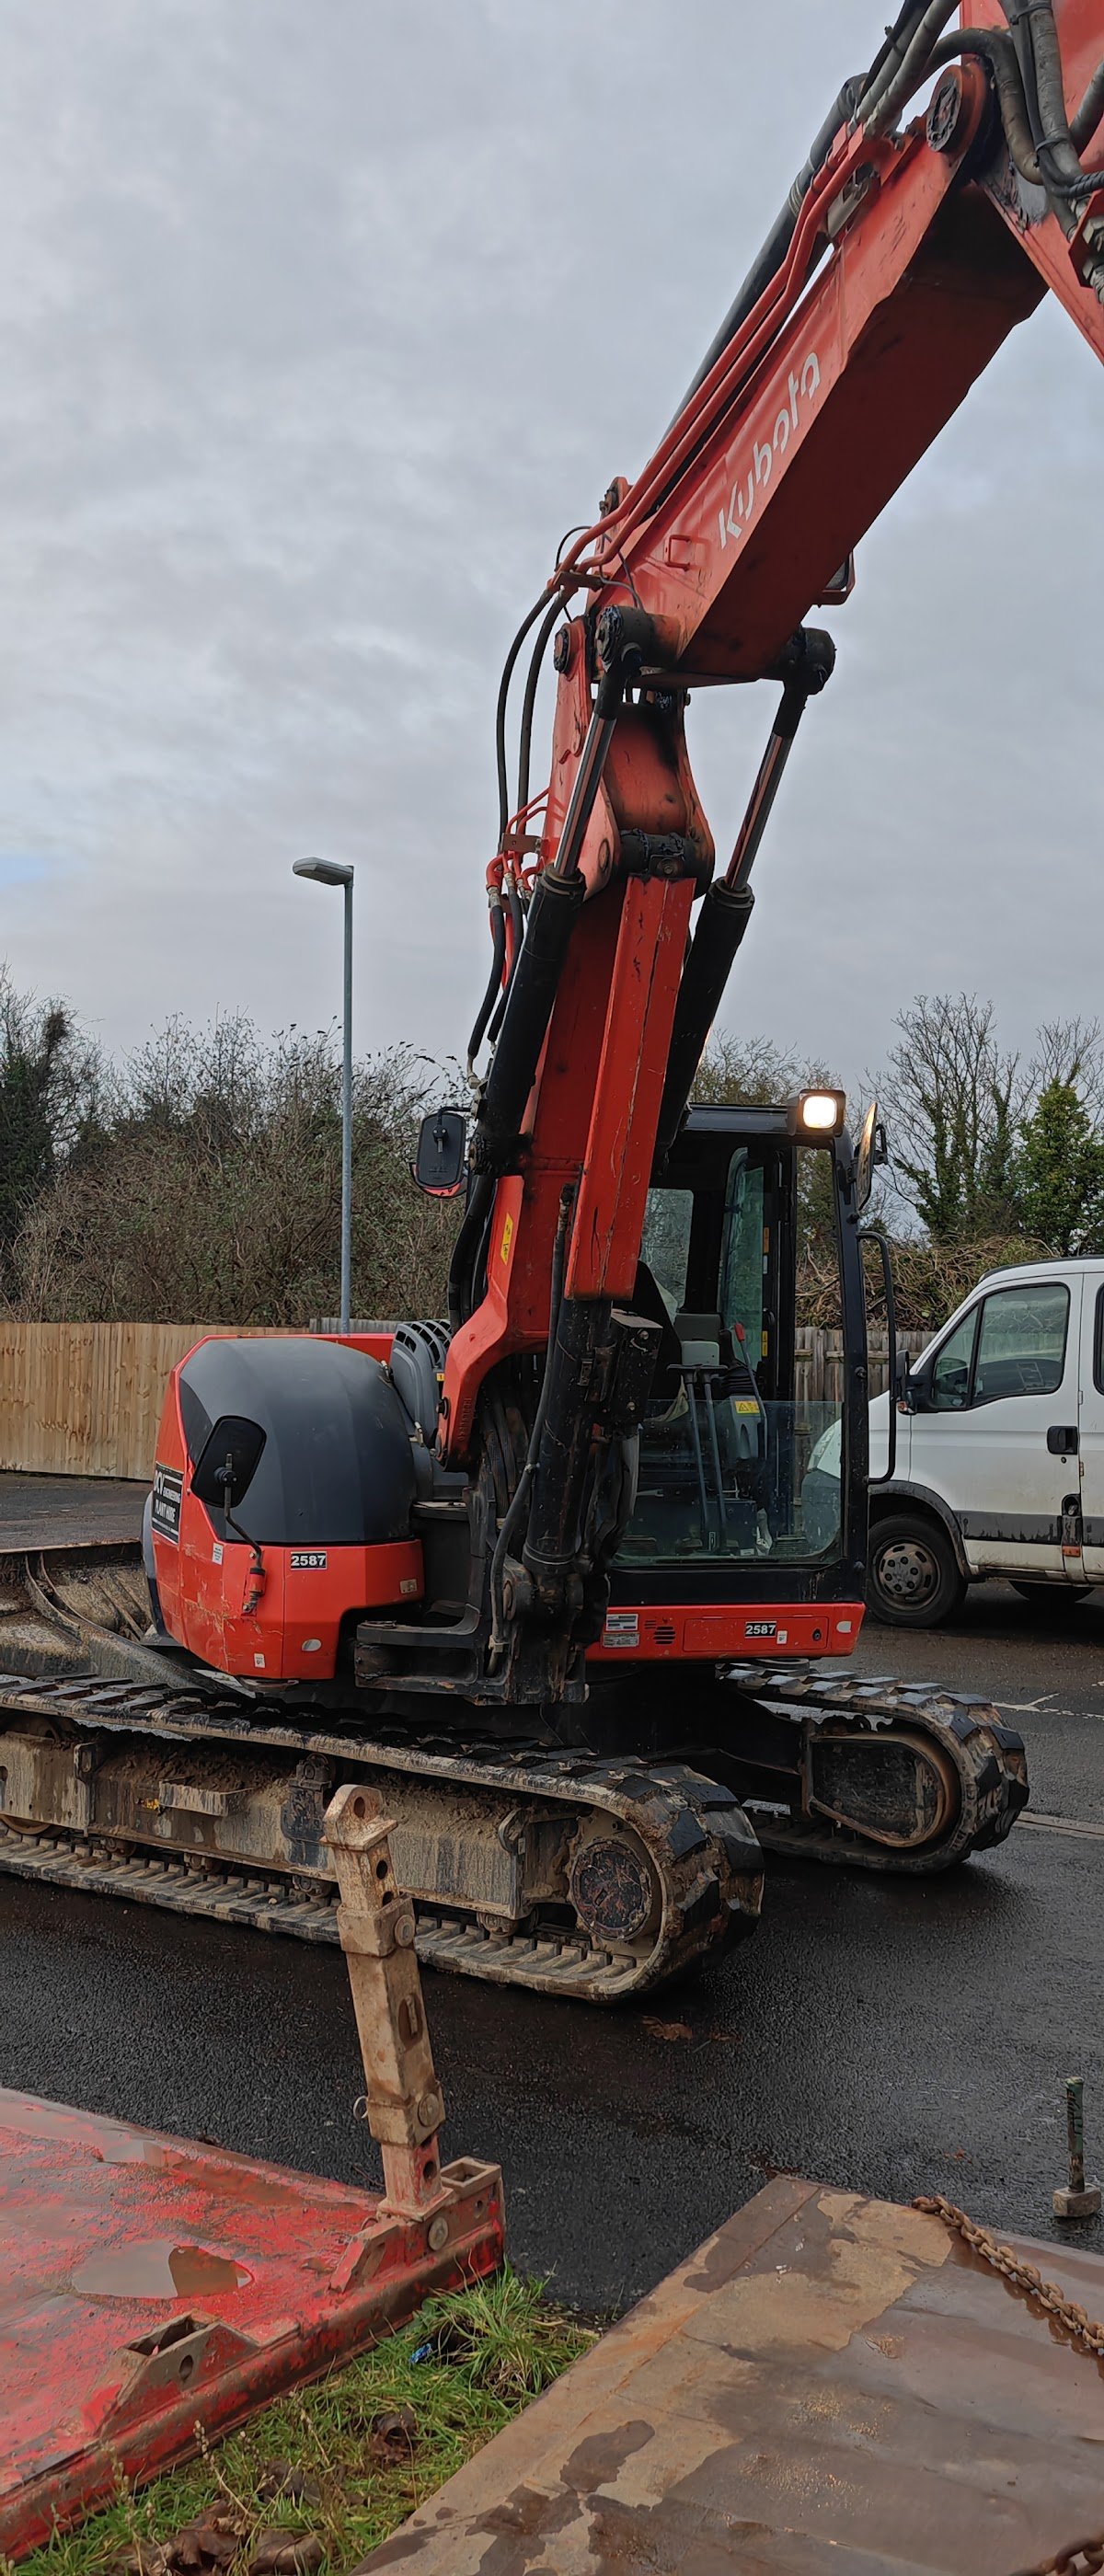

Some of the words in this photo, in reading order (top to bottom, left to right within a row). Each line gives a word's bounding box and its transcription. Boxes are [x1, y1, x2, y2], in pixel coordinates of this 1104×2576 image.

[718, 351, 821, 549] Kubota
[291, 1555, 327, 1566] 2587
[746, 1624, 776, 1635] 2587
